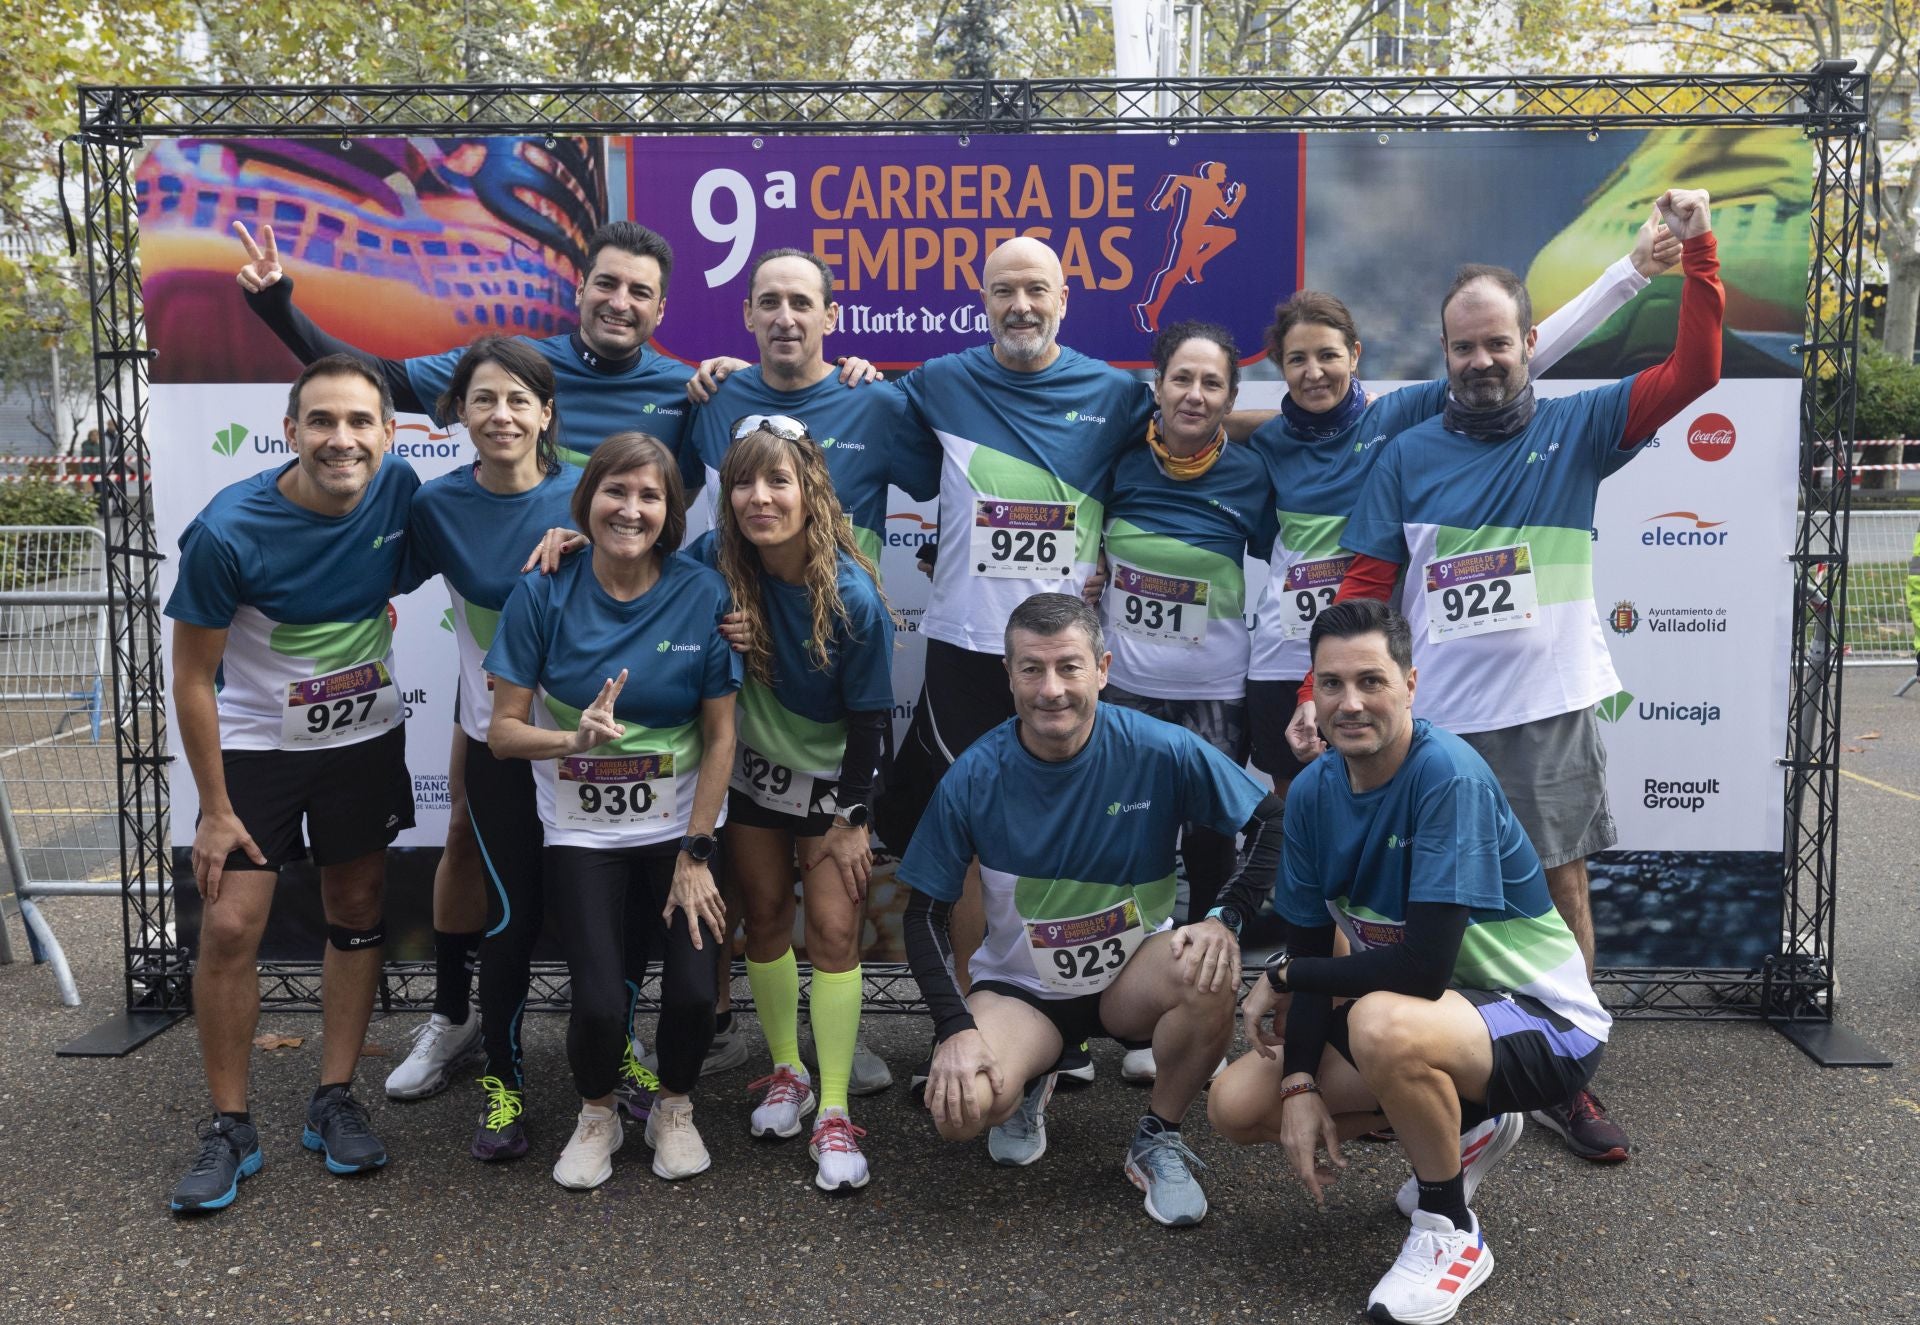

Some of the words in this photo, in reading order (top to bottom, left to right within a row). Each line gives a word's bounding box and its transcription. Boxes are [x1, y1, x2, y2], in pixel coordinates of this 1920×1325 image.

[811, 164, 1053, 219] CARRERA
[1069, 164, 1135, 218] DE
[813, 226, 1134, 291] EMPRAS
[849, 304, 917, 334] Norte
[920, 306, 946, 333] de
[1080, 414, 1106, 425] Unicaja
[254, 435, 290, 454] Uni
[392, 442, 460, 458] lecnor
[836, 441, 865, 452] Unicaja
[1009, 505, 1039, 514] CARRERA
[1009, 512, 1048, 521] EMPRESAS
[1641, 526, 1728, 546] elecnor
[992, 529, 1057, 563] 926
[1452, 557, 1485, 569] CARRERA
[1454, 562, 1496, 577] EMPRESAS
[1141, 575, 1170, 587] CARRERA
[1141, 582, 1177, 595] EMPRESAS
[1443, 579, 1515, 622] 922
[1125, 595, 1183, 632] 931
[1649, 608, 1713, 617] Ayuntamiento
[1715, 608, 1727, 616] de
[1649, 618, 1727, 633] Valladolid
[671, 643, 701, 653] Unicaja
[326, 672, 355, 686] CARRERA
[355, 669, 363, 678] DE
[326, 677, 365, 694] EMPRESAS
[307, 692, 377, 734] 927
[1639, 702, 1721, 726] Unicaja
[595, 760, 627, 768] CARRERA
[629, 759, 639, 768] DE
[743, 748, 793, 795] 929
[595, 767, 639, 777] EMPRESAS
[1644, 779, 1720, 794] Renault
[579, 783, 653, 816] 930
[1643, 794, 1705, 813] Group
[1063, 919, 1097, 931] CARRERA
[1097, 916, 1106, 925] DE
[1064, 924, 1107, 939] EMPRESAS
[1053, 938, 1126, 979] 923
